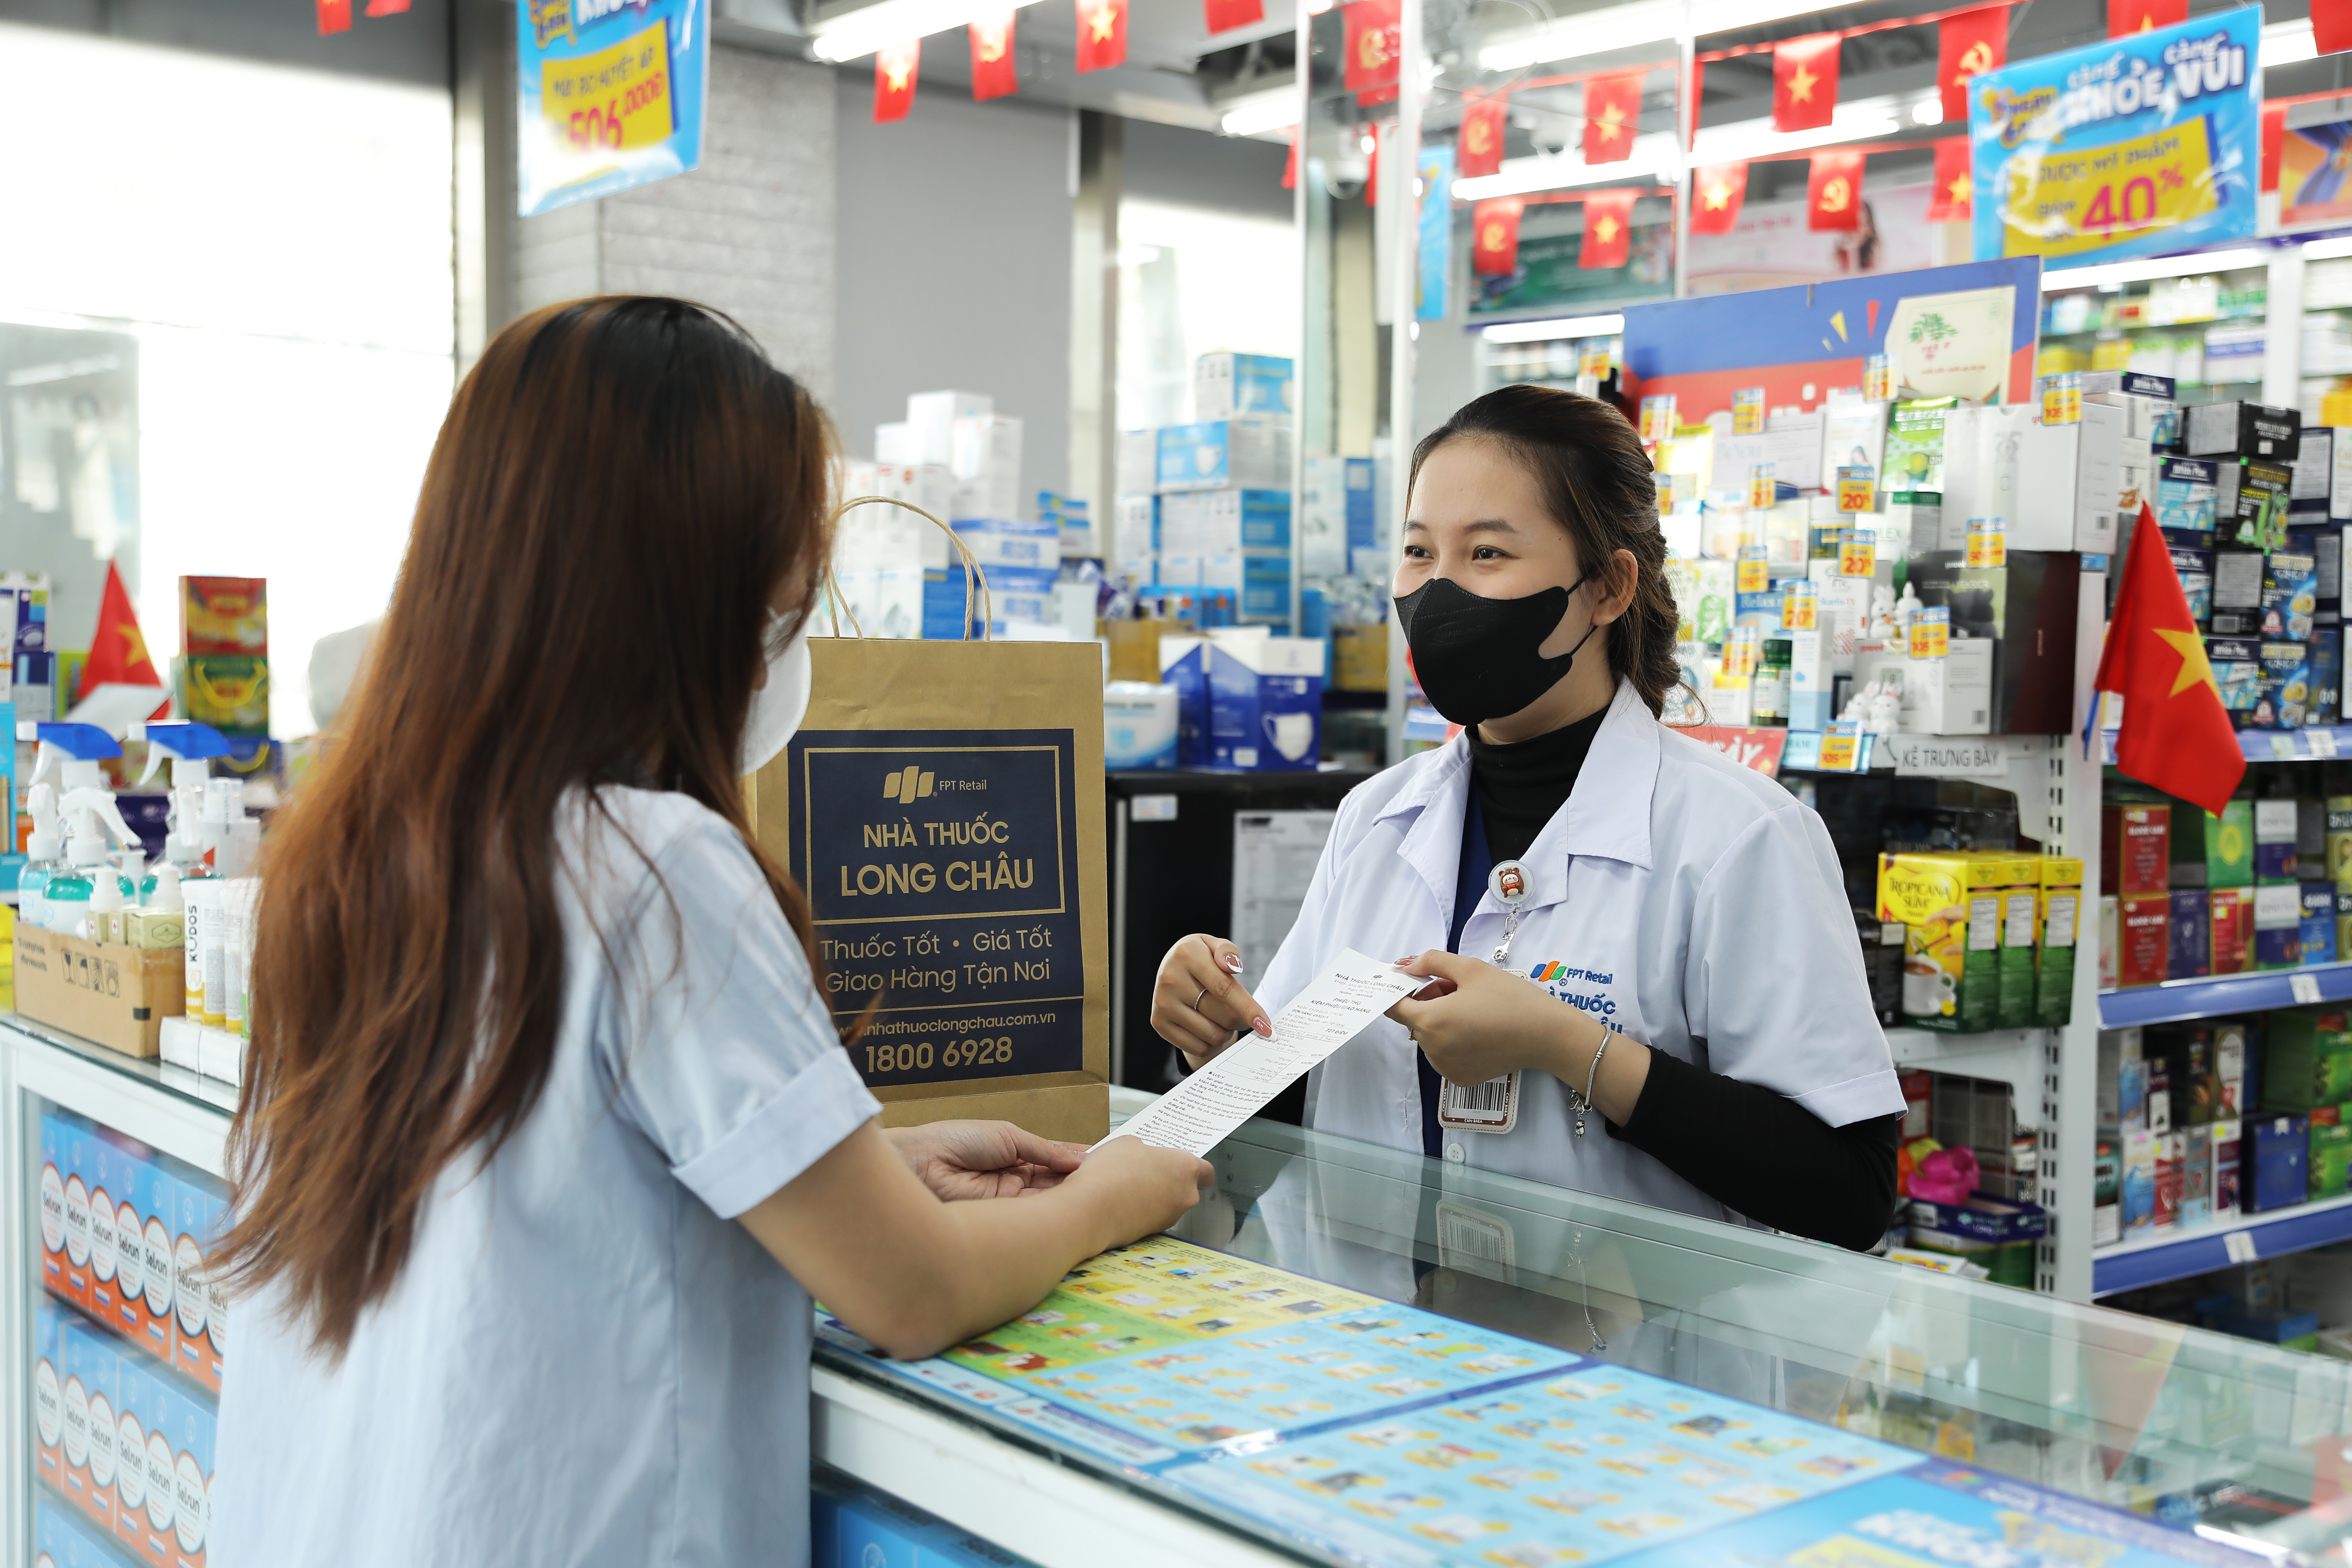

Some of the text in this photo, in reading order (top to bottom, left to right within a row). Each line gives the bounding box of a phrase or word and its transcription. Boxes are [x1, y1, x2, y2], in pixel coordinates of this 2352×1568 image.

[2173, 45, 2245, 98] VUI
[1903, 746, 1999, 769] KỆ TRƯNG BÀY
[939, 779, 987, 791] FPT Retail
[864, 812, 1010, 848] NHÀ THUỐC
[841, 851, 1034, 897] LONG CHÂU
[1889, 878, 1951, 902] TROPICANA
[819, 925, 1052, 960] Thuốc Tốt Giá Tốt
[824, 958, 1050, 993] Giao Hàng Tận Nơi
[1567, 968, 1613, 984] FPT Retail
[1560, 993, 1616, 1014] THUỐC
[866, 1037, 1013, 1073] 1800 6928
